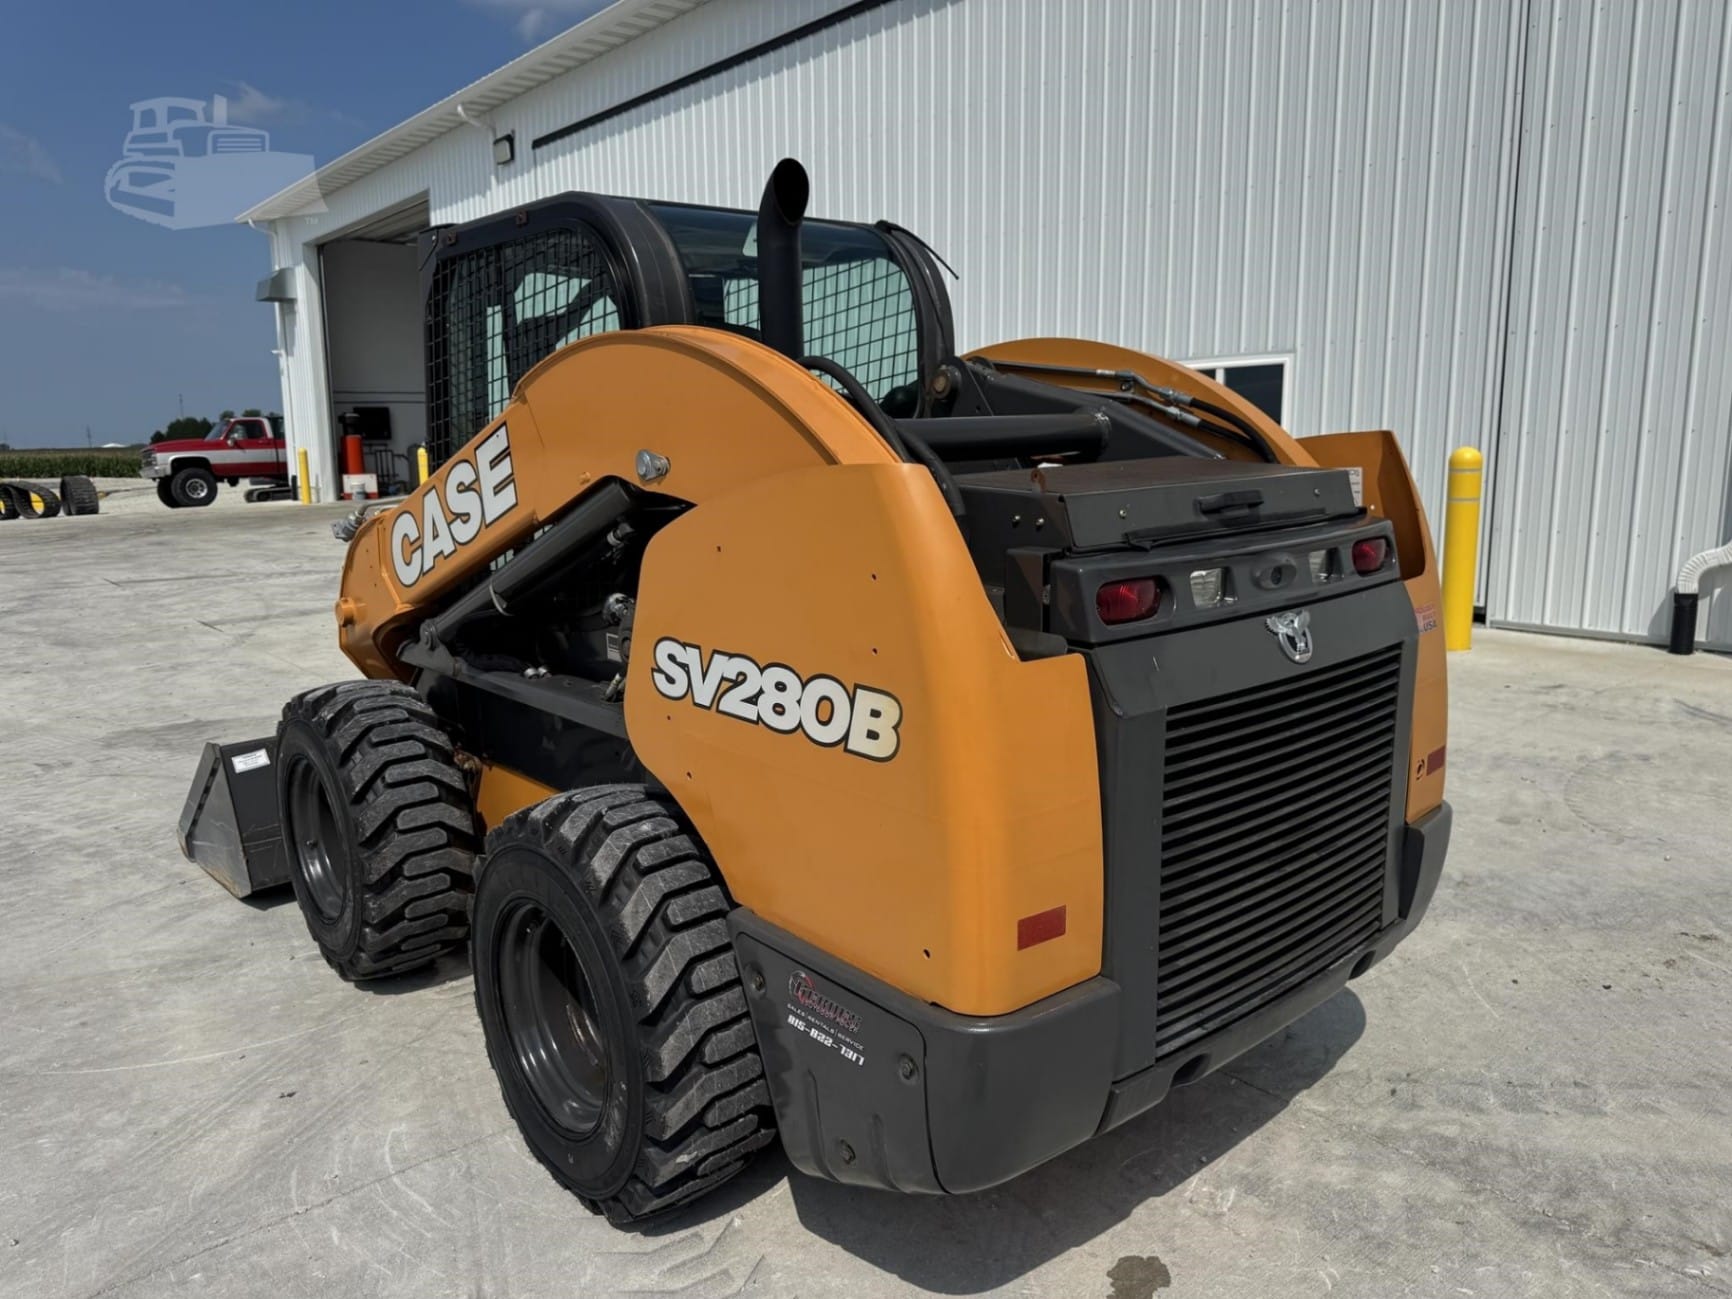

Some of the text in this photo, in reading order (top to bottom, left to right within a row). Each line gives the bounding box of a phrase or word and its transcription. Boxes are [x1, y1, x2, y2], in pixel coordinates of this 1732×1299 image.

[391, 421, 518, 588] CASE
[651, 636, 903, 763] SV280B
[808, 1015, 836, 1035] RENTALS
[837, 1032, 865, 1051] SERVICE
